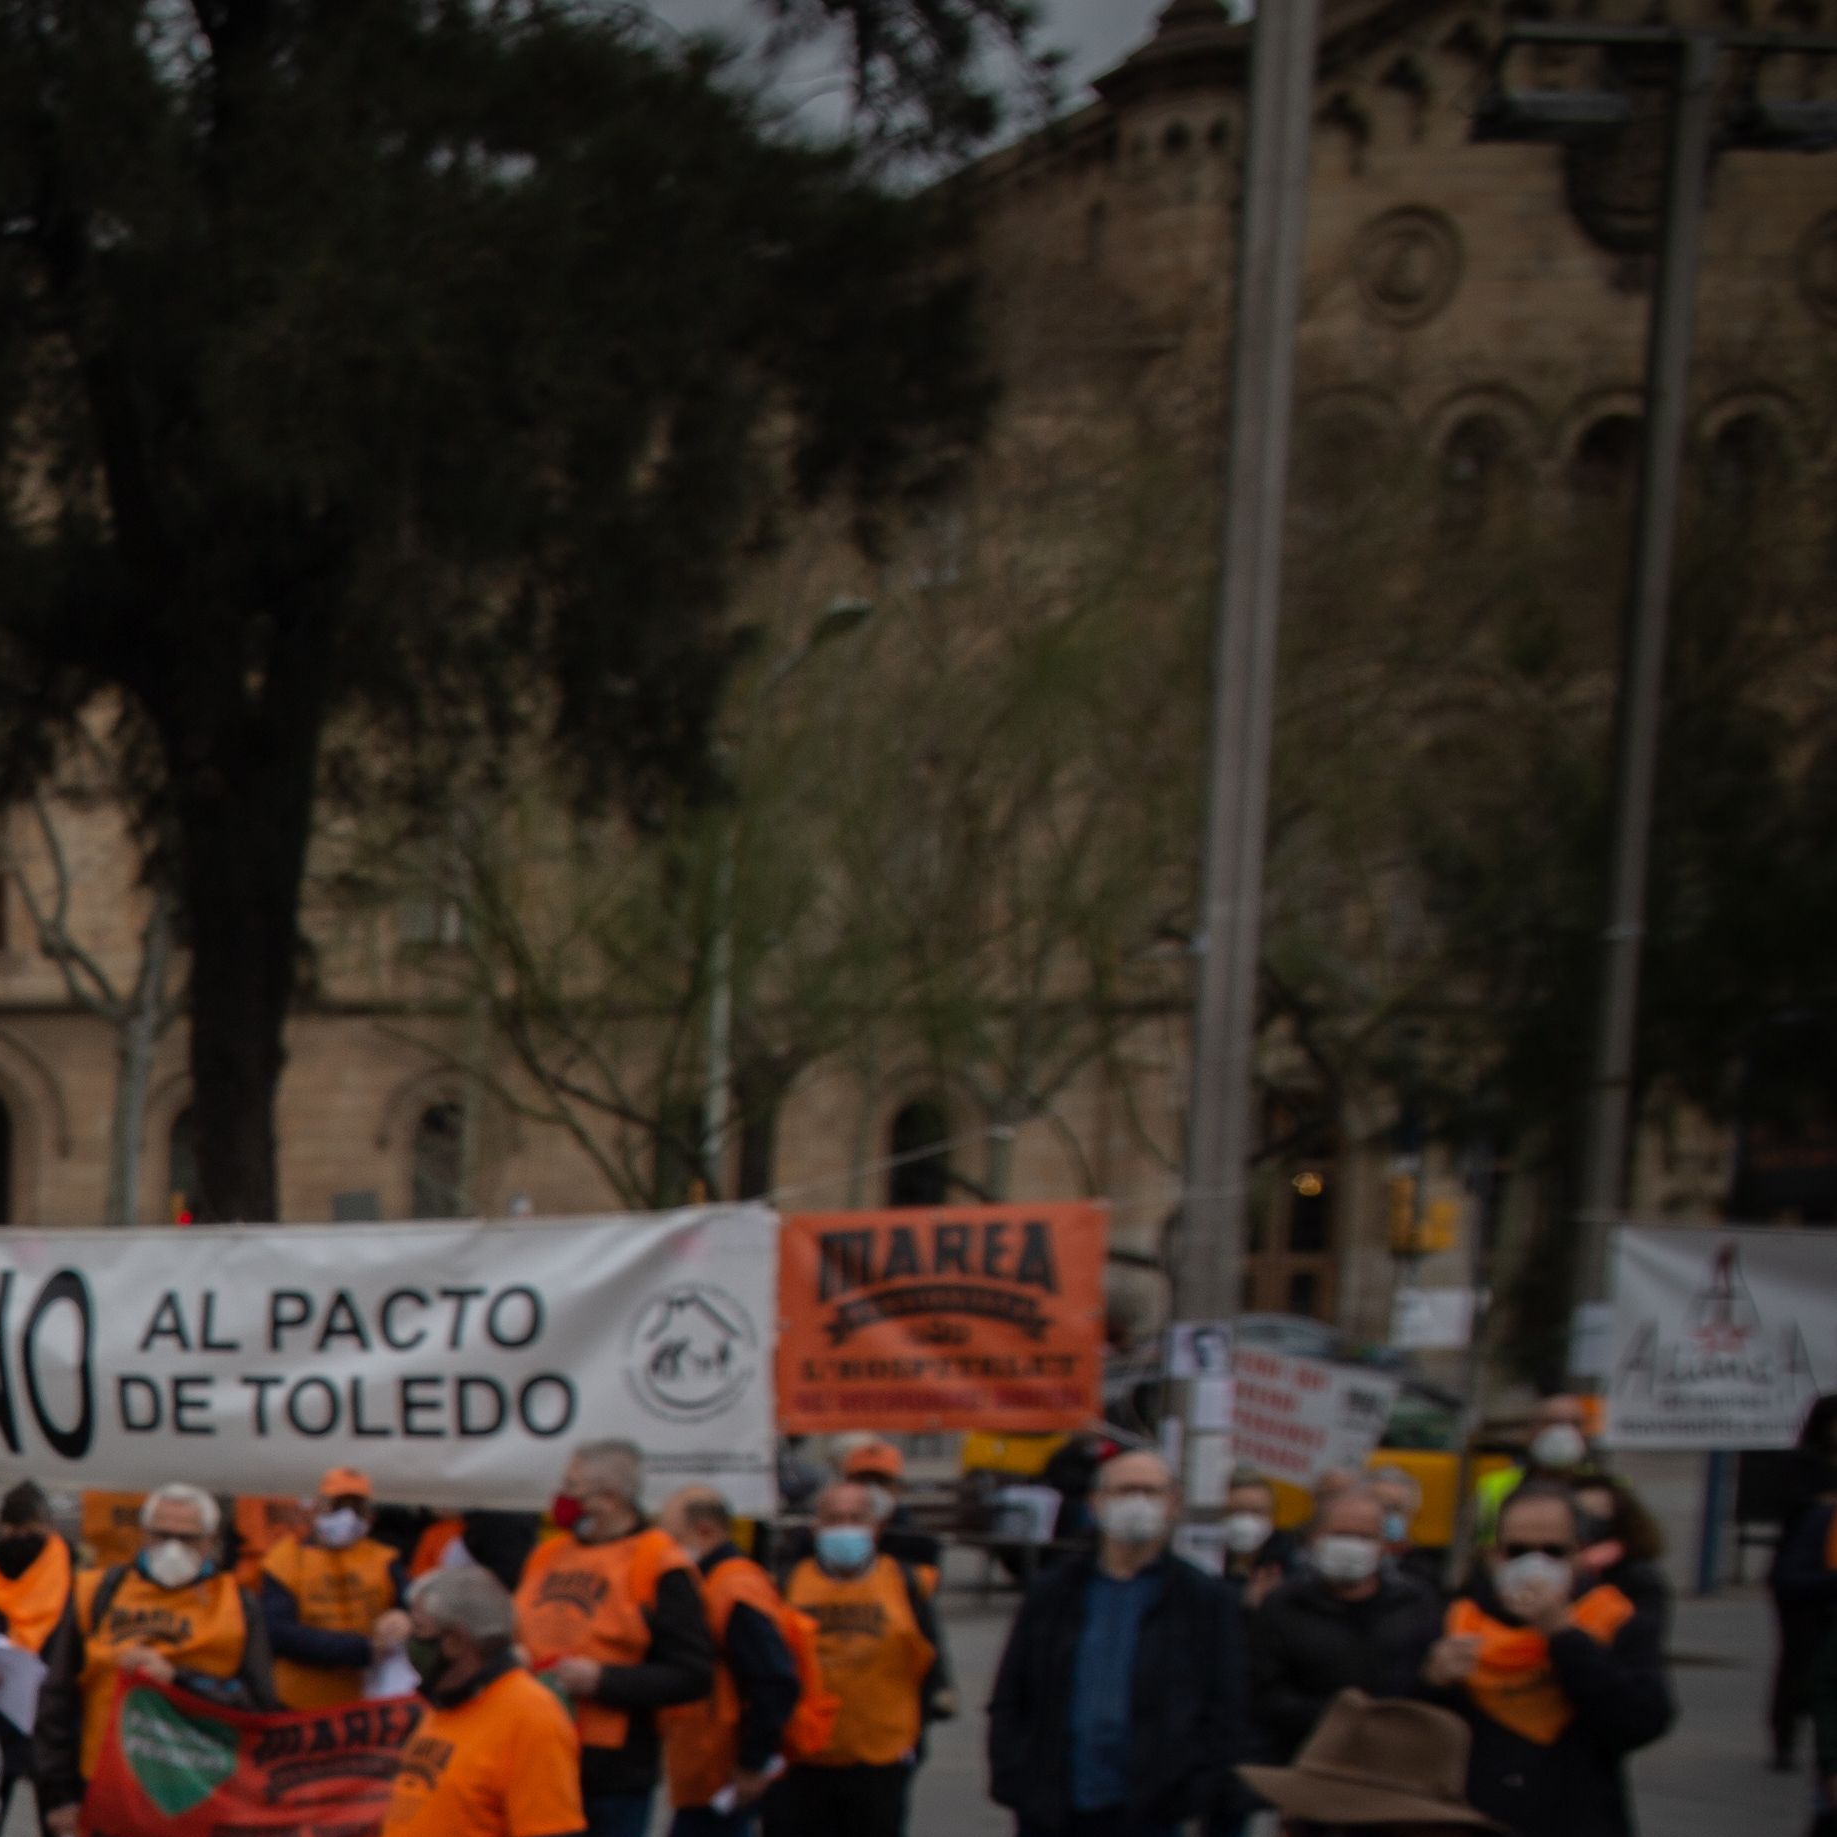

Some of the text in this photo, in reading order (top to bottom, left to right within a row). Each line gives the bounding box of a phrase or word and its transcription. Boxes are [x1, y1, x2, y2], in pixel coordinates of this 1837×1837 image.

[818, 1221, 1060, 1304] MAREA
[139, 1286, 545, 1353] AL PACTO
[118, 1371, 577, 1440] DE TOLEDO
